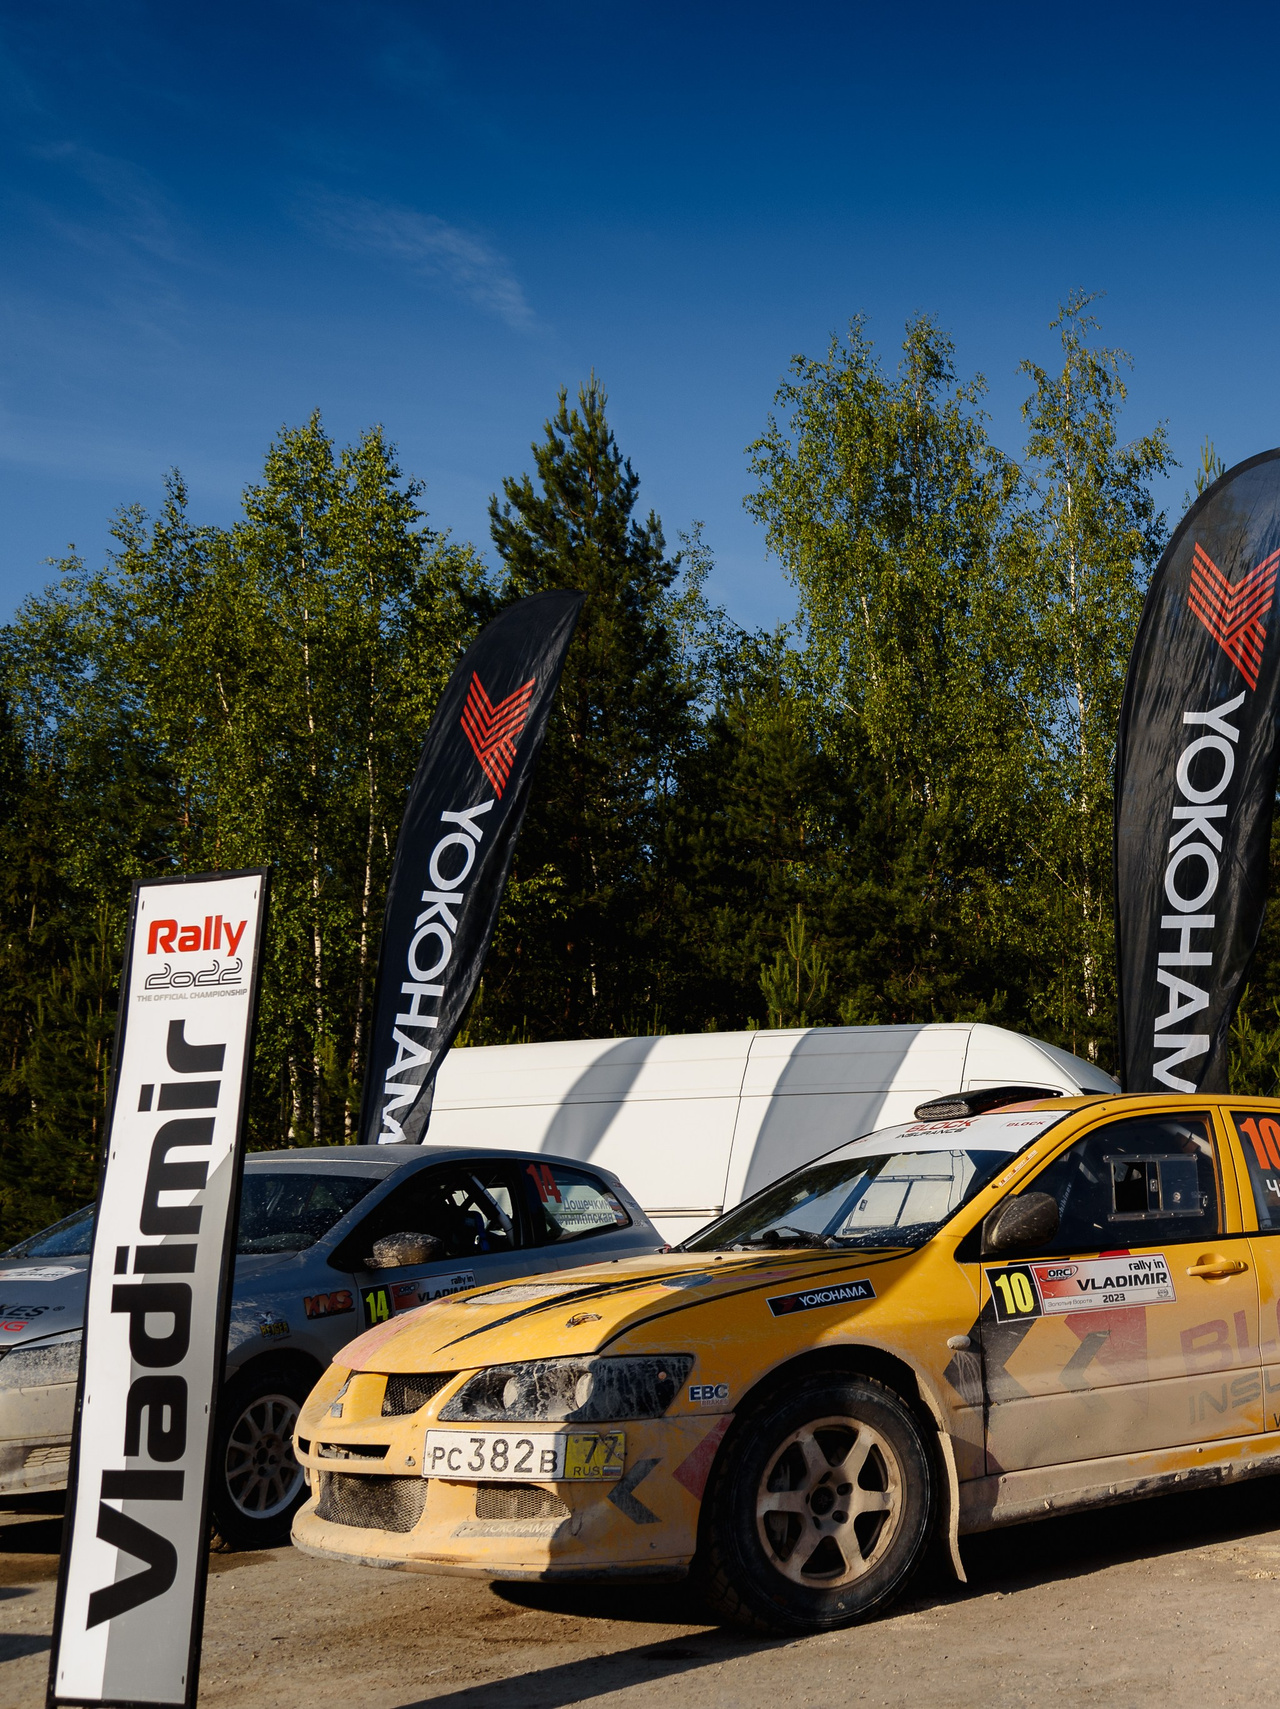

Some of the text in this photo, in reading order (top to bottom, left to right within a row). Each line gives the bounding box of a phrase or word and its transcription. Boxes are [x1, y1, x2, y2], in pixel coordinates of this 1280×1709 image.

[1153, 690, 1246, 1093] YOKOHAM
[147, 915, 248, 957] Rally
[144, 958, 243, 990] 2022
[378, 799, 494, 1144] YOKOHAM
[153, 993, 188, 1001] OFFICIAL
[190, 988, 248, 999] CHAMPIONSHIP
[906, 1119, 979, 1132] BLOCK
[526, 1164, 562, 1203] 14
[1129, 1259, 1164, 1272] rally in
[450, 1274, 474, 1286] rally in
[995, 1272, 1034, 1314] 10
[1077, 1272, 1168, 1291] VLADIMIR
[304, 1290, 353, 1316] KMS
[366, 1290, 389, 1324] 14
[799, 1285, 867, 1307] YOKOHAMA
[1102, 1293, 1126, 1303] 2023
[86, 1019, 226, 1630] Vladimir
[691, 1384, 728, 1401] EBC
[583, 1436, 619, 1464] 77
[573, 1466, 600, 1477] RUS
